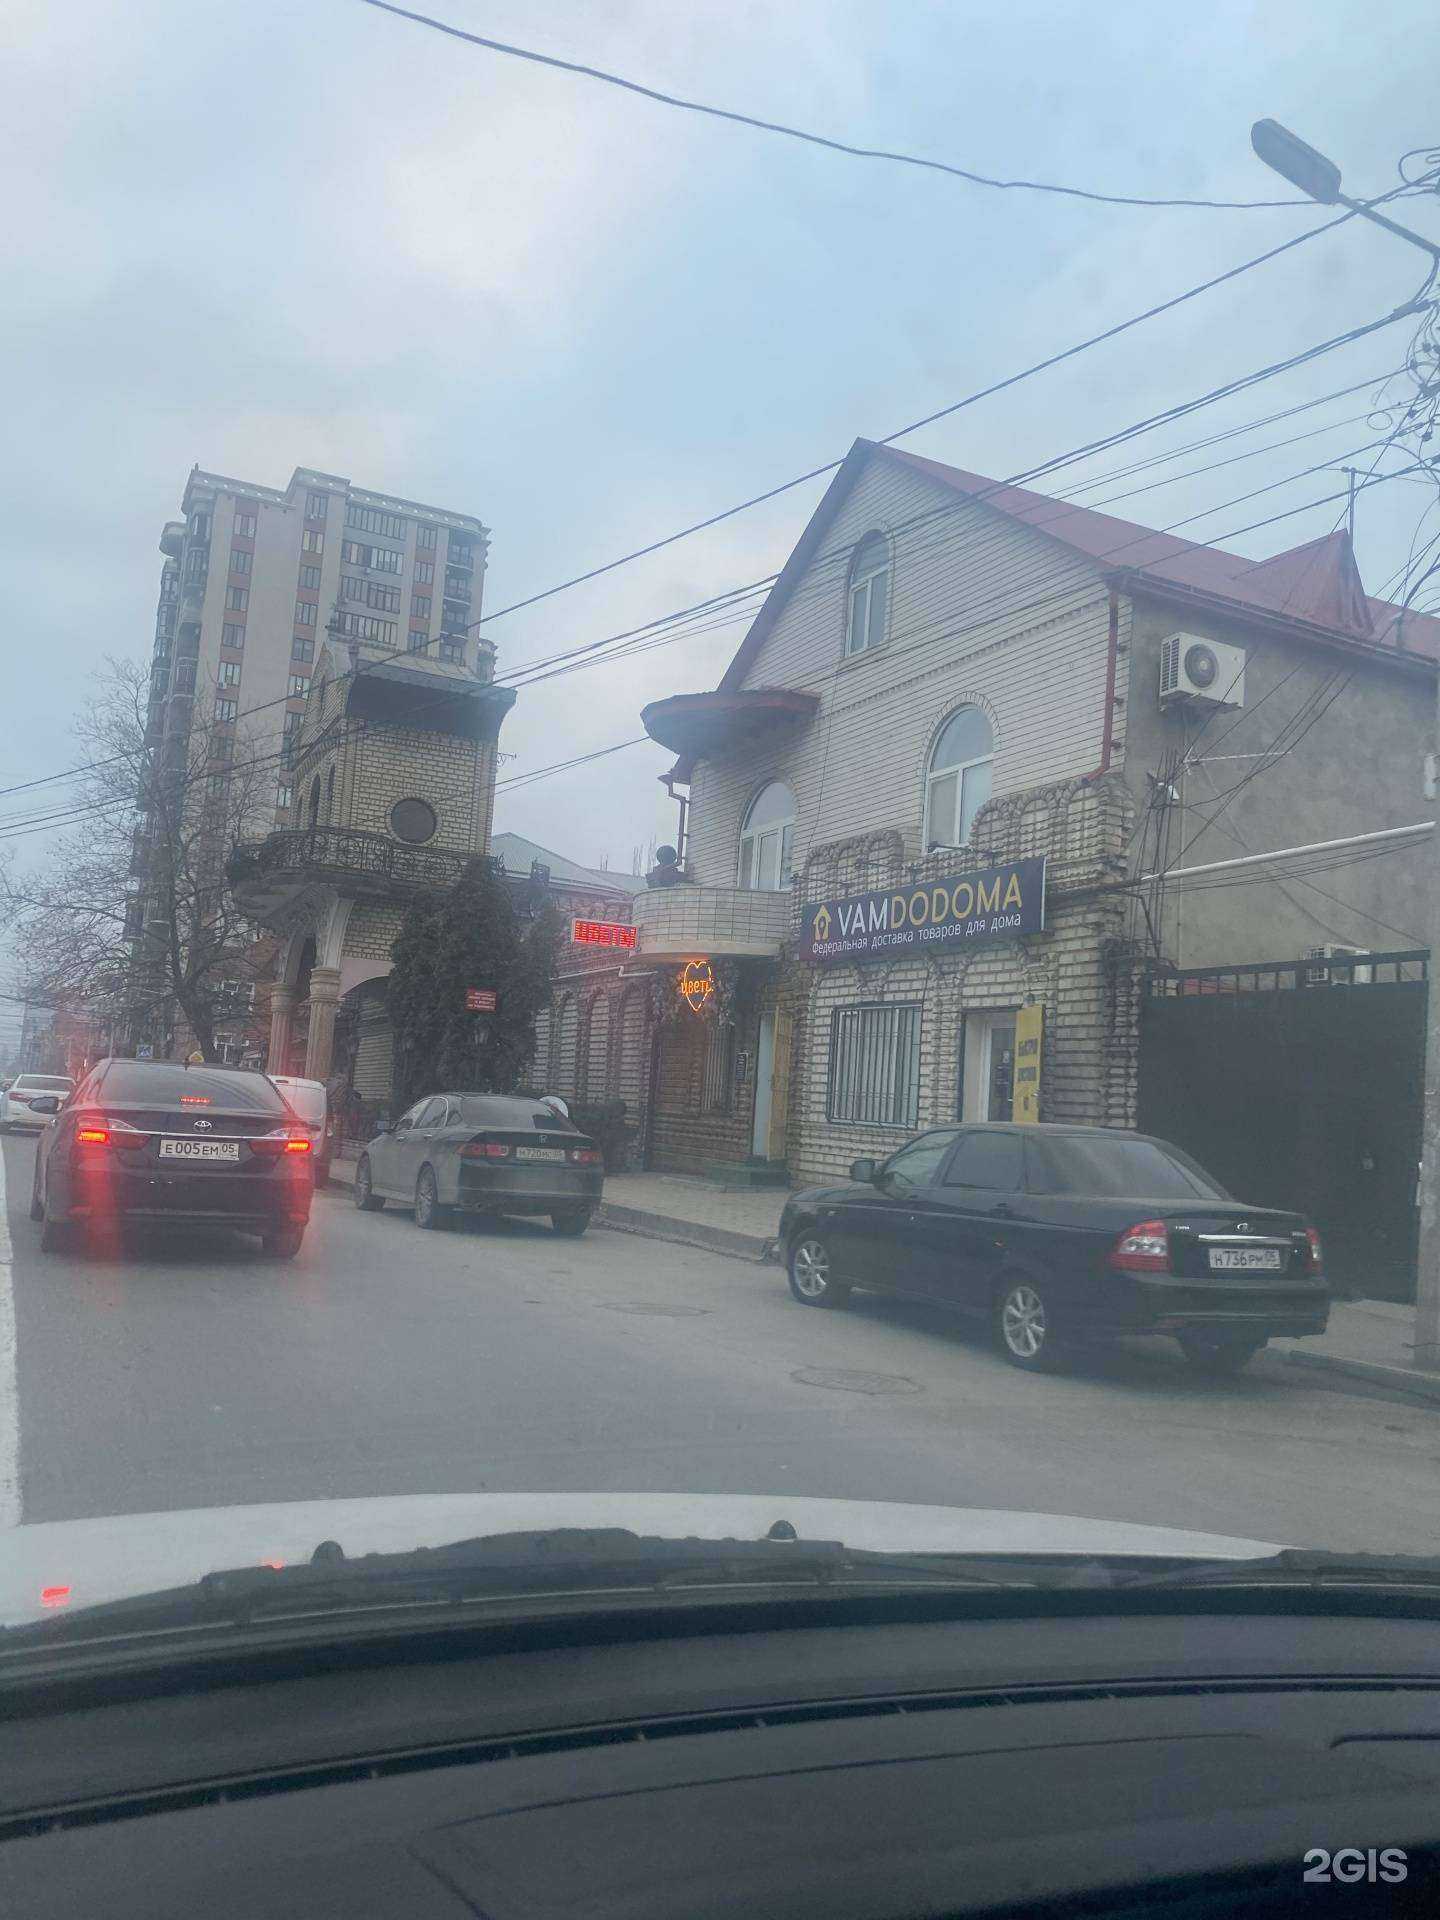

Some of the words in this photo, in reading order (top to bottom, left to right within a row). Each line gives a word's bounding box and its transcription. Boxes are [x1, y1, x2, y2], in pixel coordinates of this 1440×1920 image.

[838, 873, 1022, 936] VAMDODOMA
[812, 938, 868, 956] Федеральная
[871, 931, 914, 950] доставка
[918, 923, 961, 941] товаров
[966, 919, 986, 936] для
[991, 913, 1021, 933] дома
